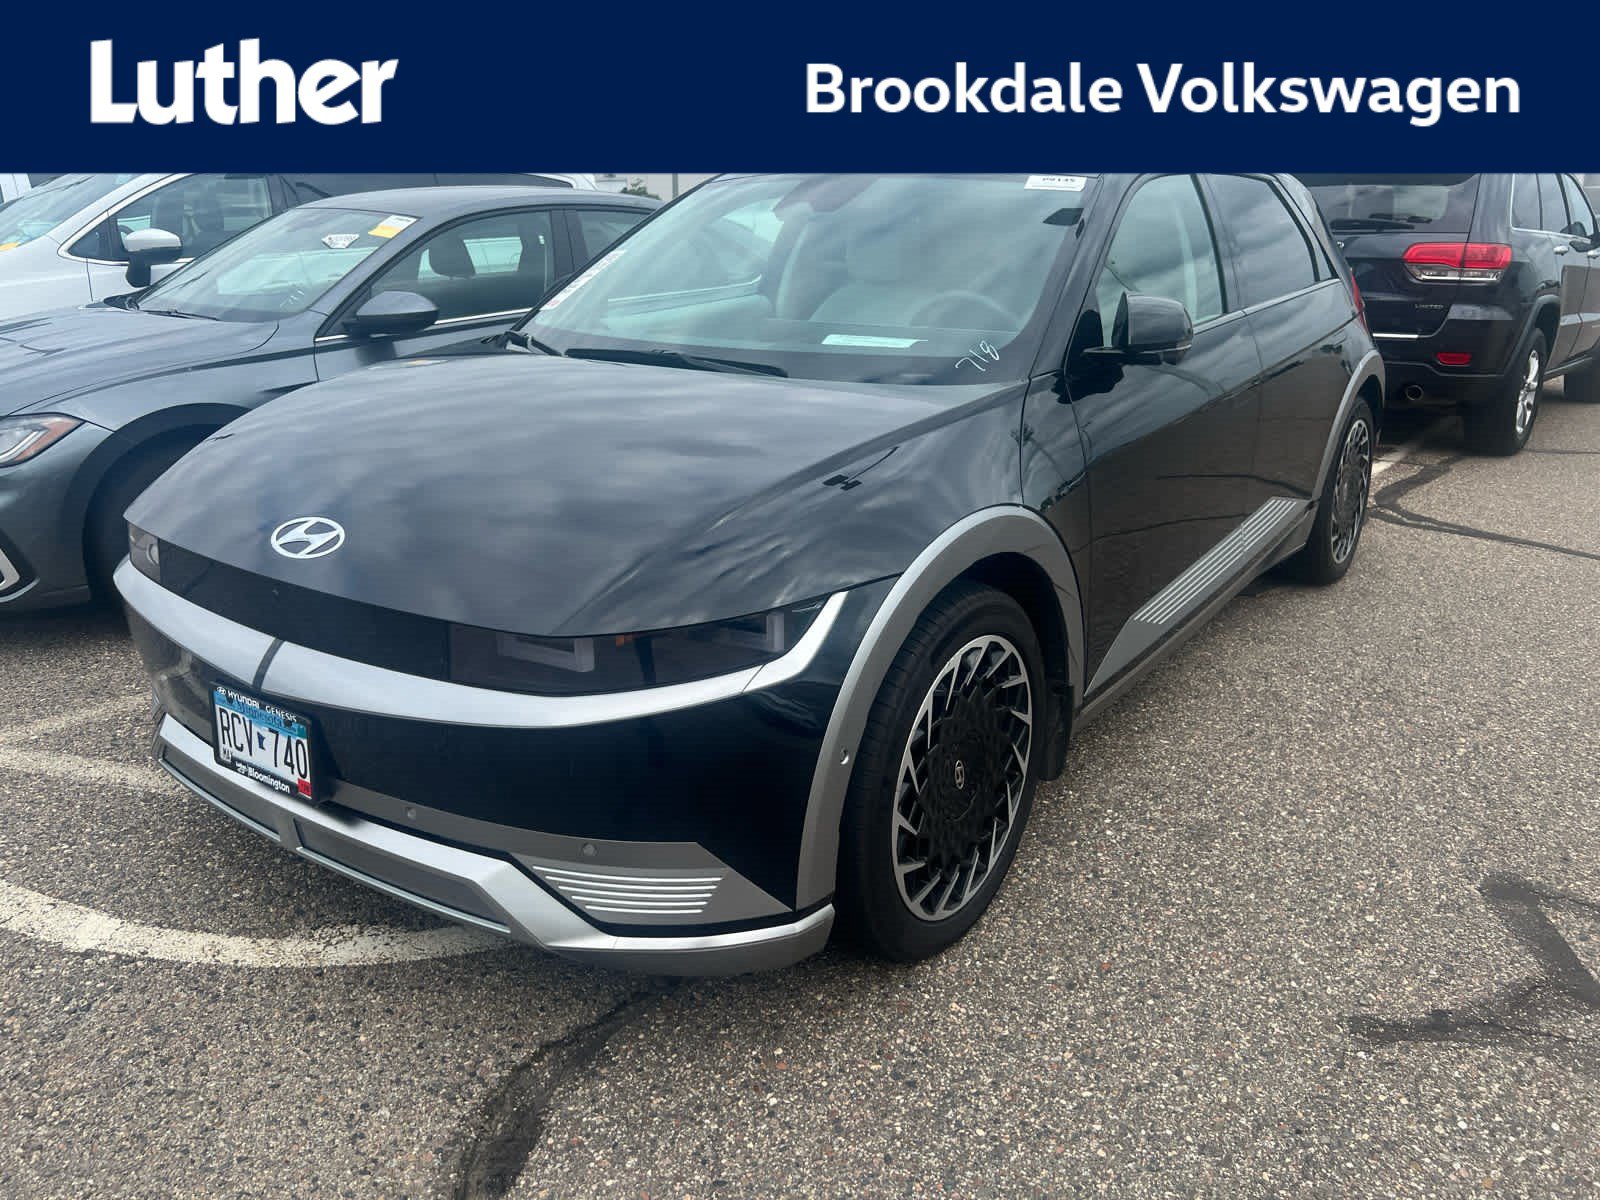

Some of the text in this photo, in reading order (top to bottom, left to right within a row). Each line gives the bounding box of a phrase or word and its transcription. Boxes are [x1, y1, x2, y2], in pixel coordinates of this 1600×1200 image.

[265, 705, 297, 723] GENESIS
[219, 707, 308, 780] RCV 740
[249, 766, 290, 794] Bloomington
